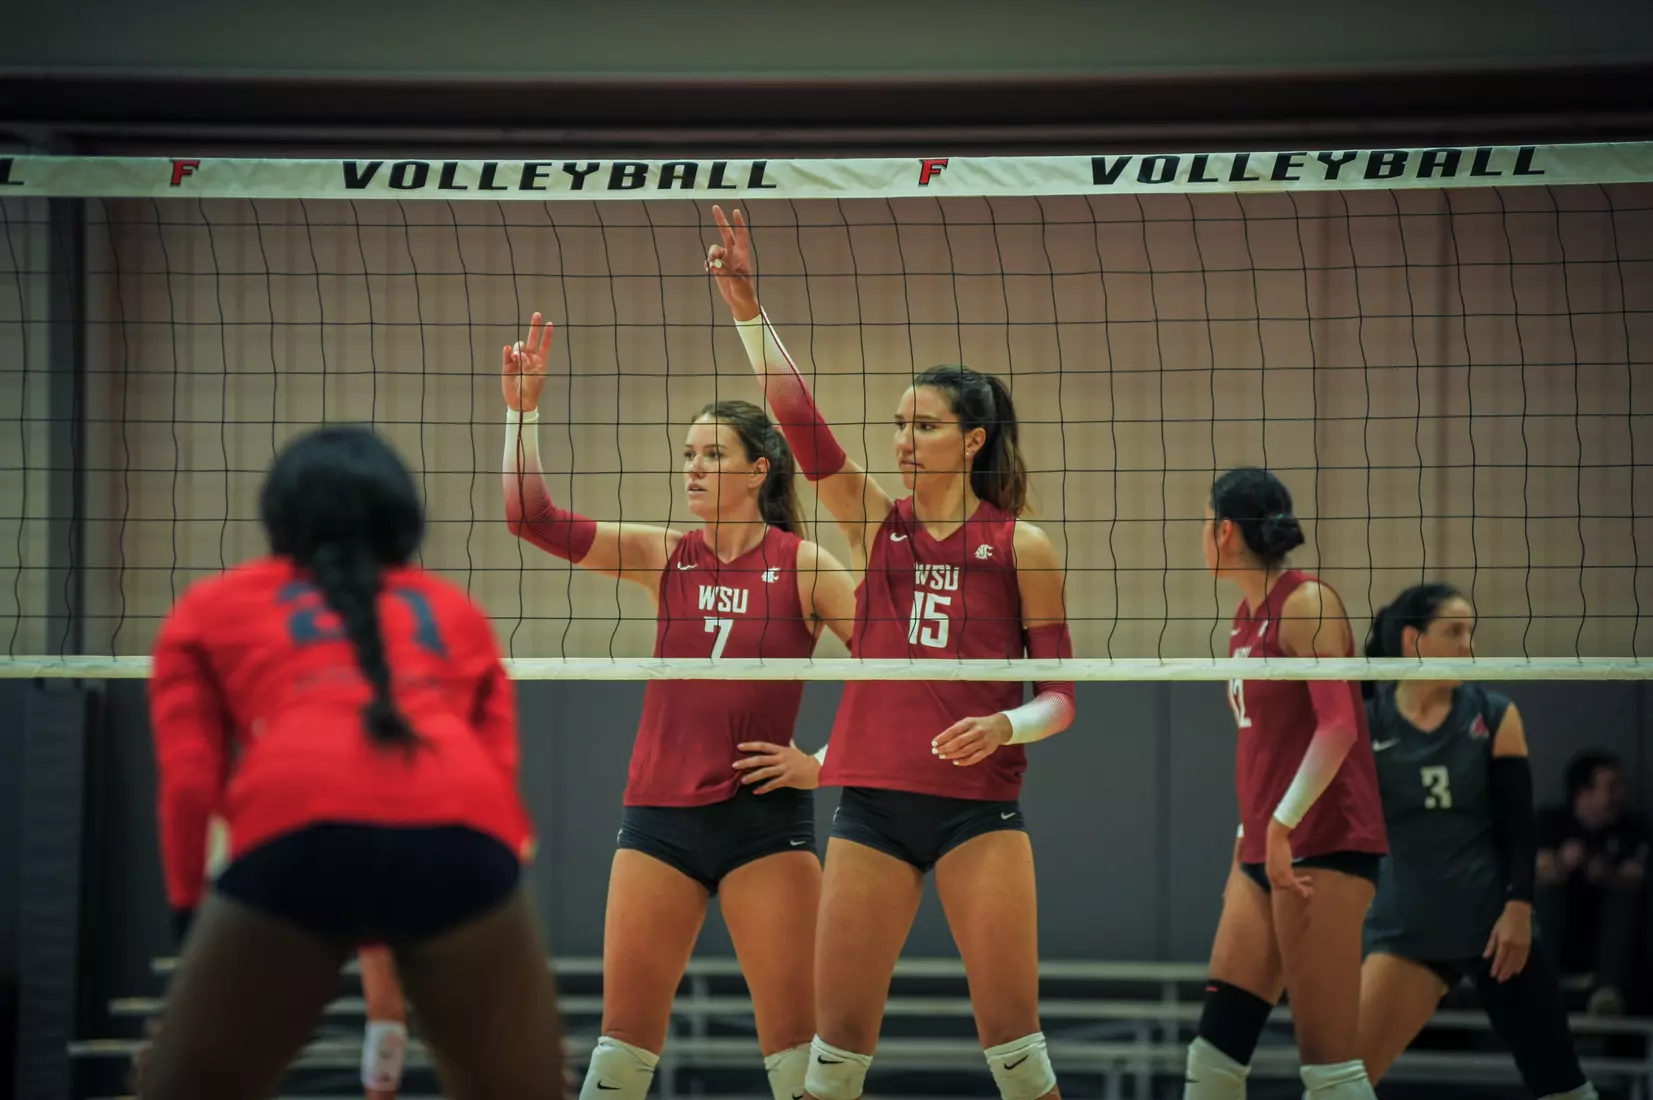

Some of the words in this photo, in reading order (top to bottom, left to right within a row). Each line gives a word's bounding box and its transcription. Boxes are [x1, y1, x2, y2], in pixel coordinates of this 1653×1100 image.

[169, 160, 200, 187] F
[343, 160, 778, 191] VOLLEYBALL
[917, 158, 949, 188] F
[1091, 146, 1546, 186] VOLLEYBALL
[914, 563, 960, 591] WSU
[698, 584, 749, 614] WSU
[908, 591, 952, 648] 15
[704, 616, 734, 659] 7
[1420, 765, 1452, 809] 3
